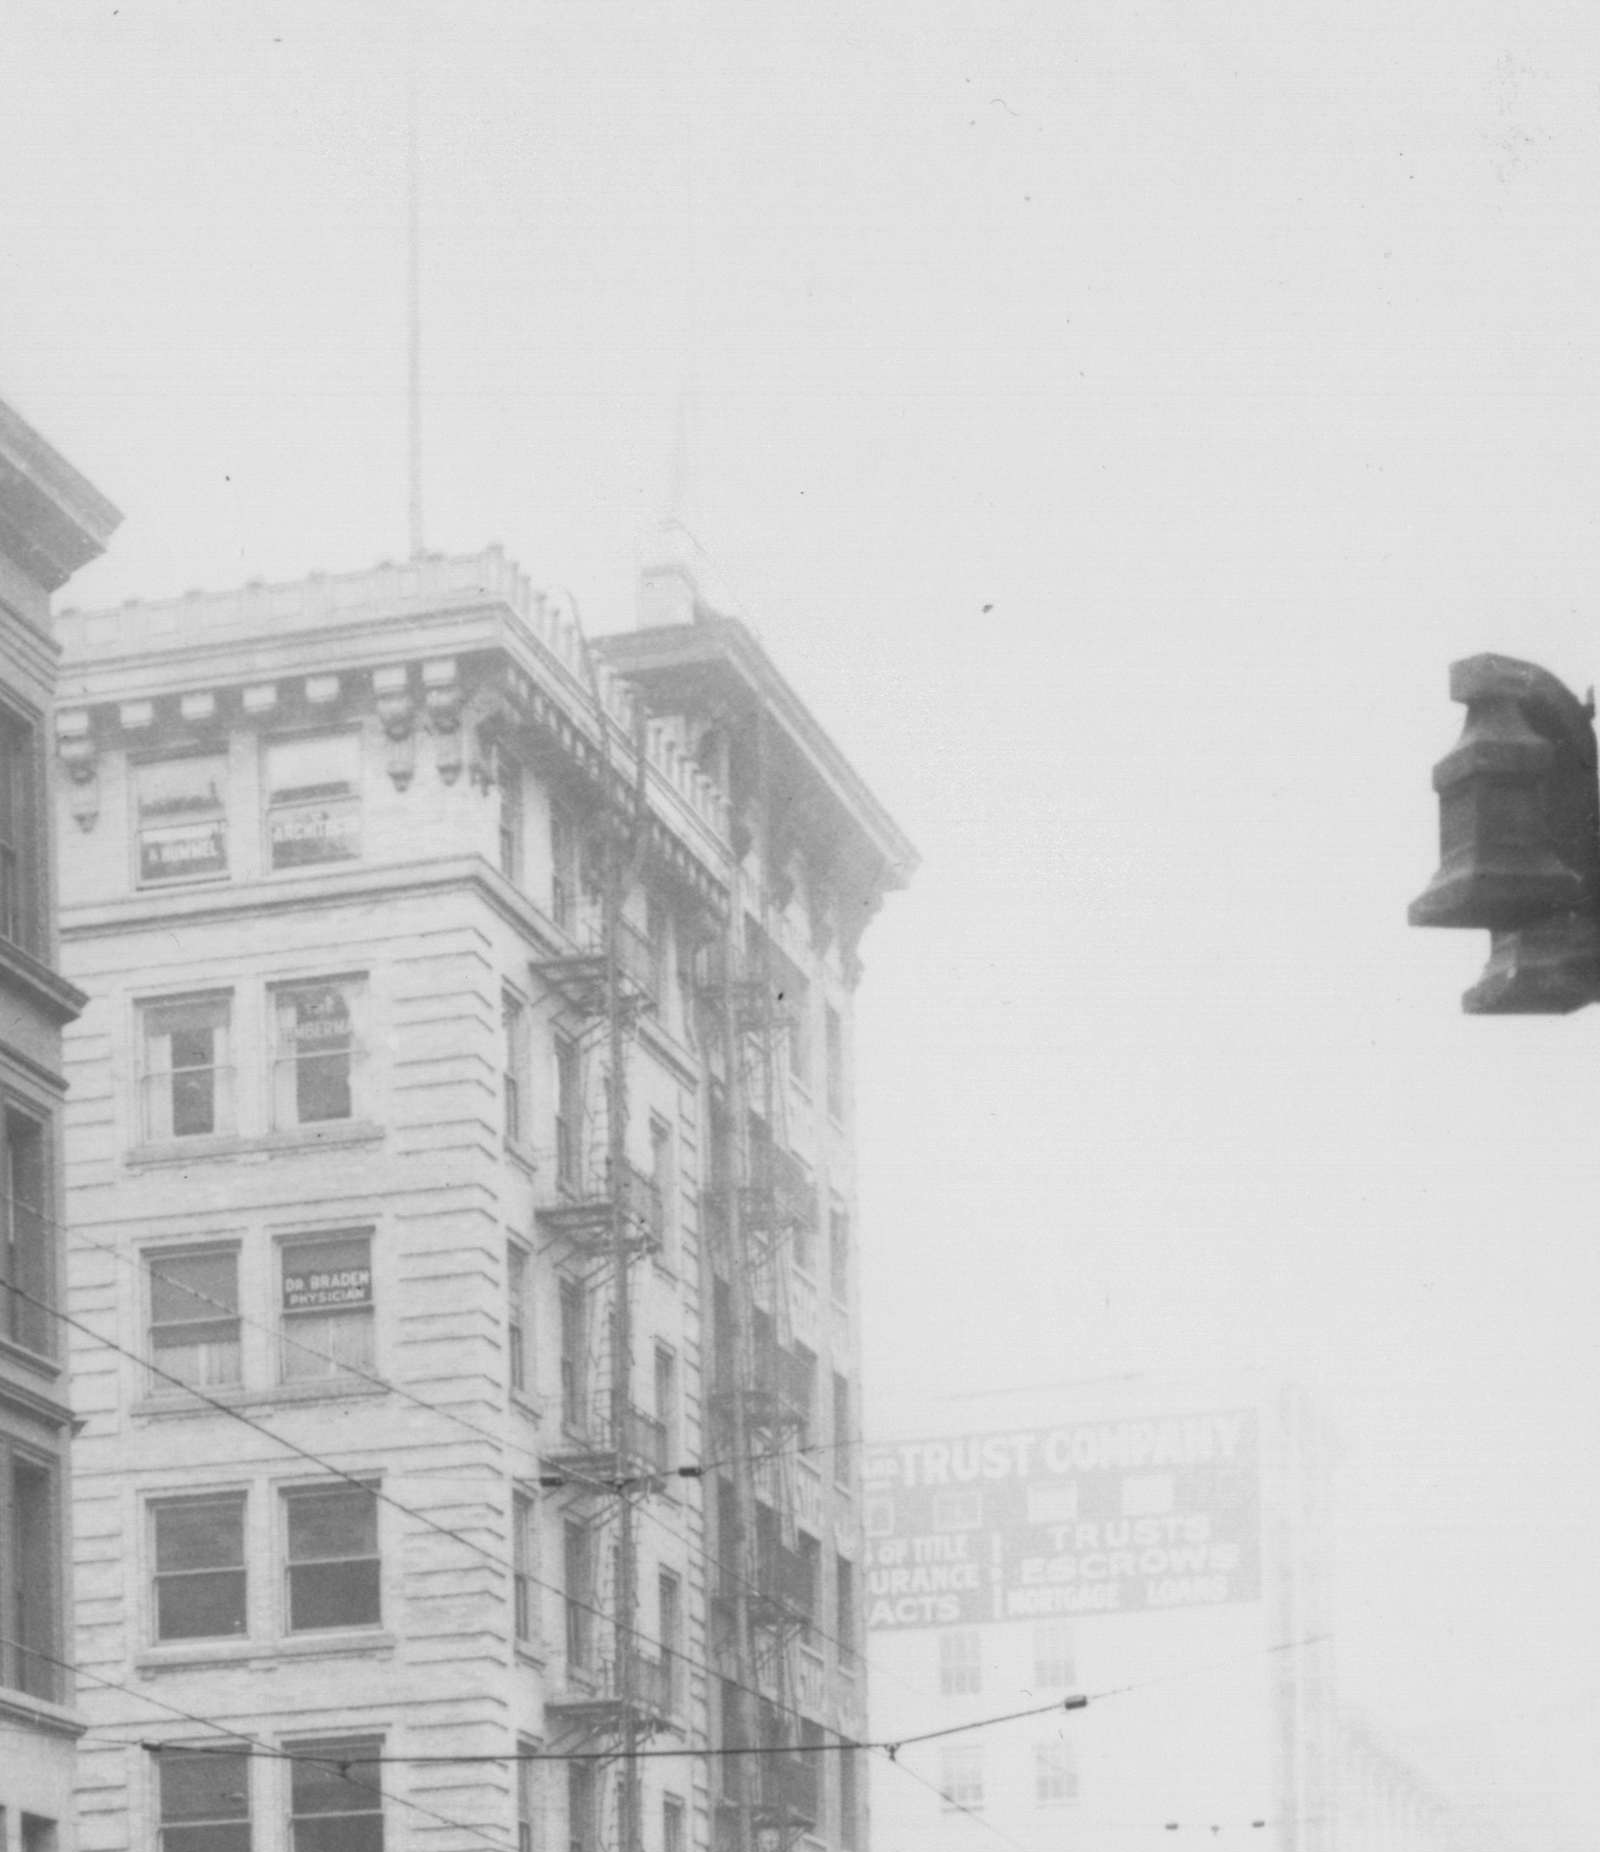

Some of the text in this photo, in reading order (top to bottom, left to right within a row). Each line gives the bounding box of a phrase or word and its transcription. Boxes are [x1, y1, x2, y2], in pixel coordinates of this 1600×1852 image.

[285, 1270, 369, 1293] DR BRADEN
[289, 1287, 365, 1306] PHYSICIAN
[898, 1432, 1038, 1487] TRUST
[1044, 1414, 1247, 1474] COMPANY
[911, 1533, 971, 1563] TITLE
[1046, 1513, 1212, 1552] TRUSTS
[868, 1563, 981, 1596] URANCE
[1020, 1543, 1242, 1586] ESCROWS
